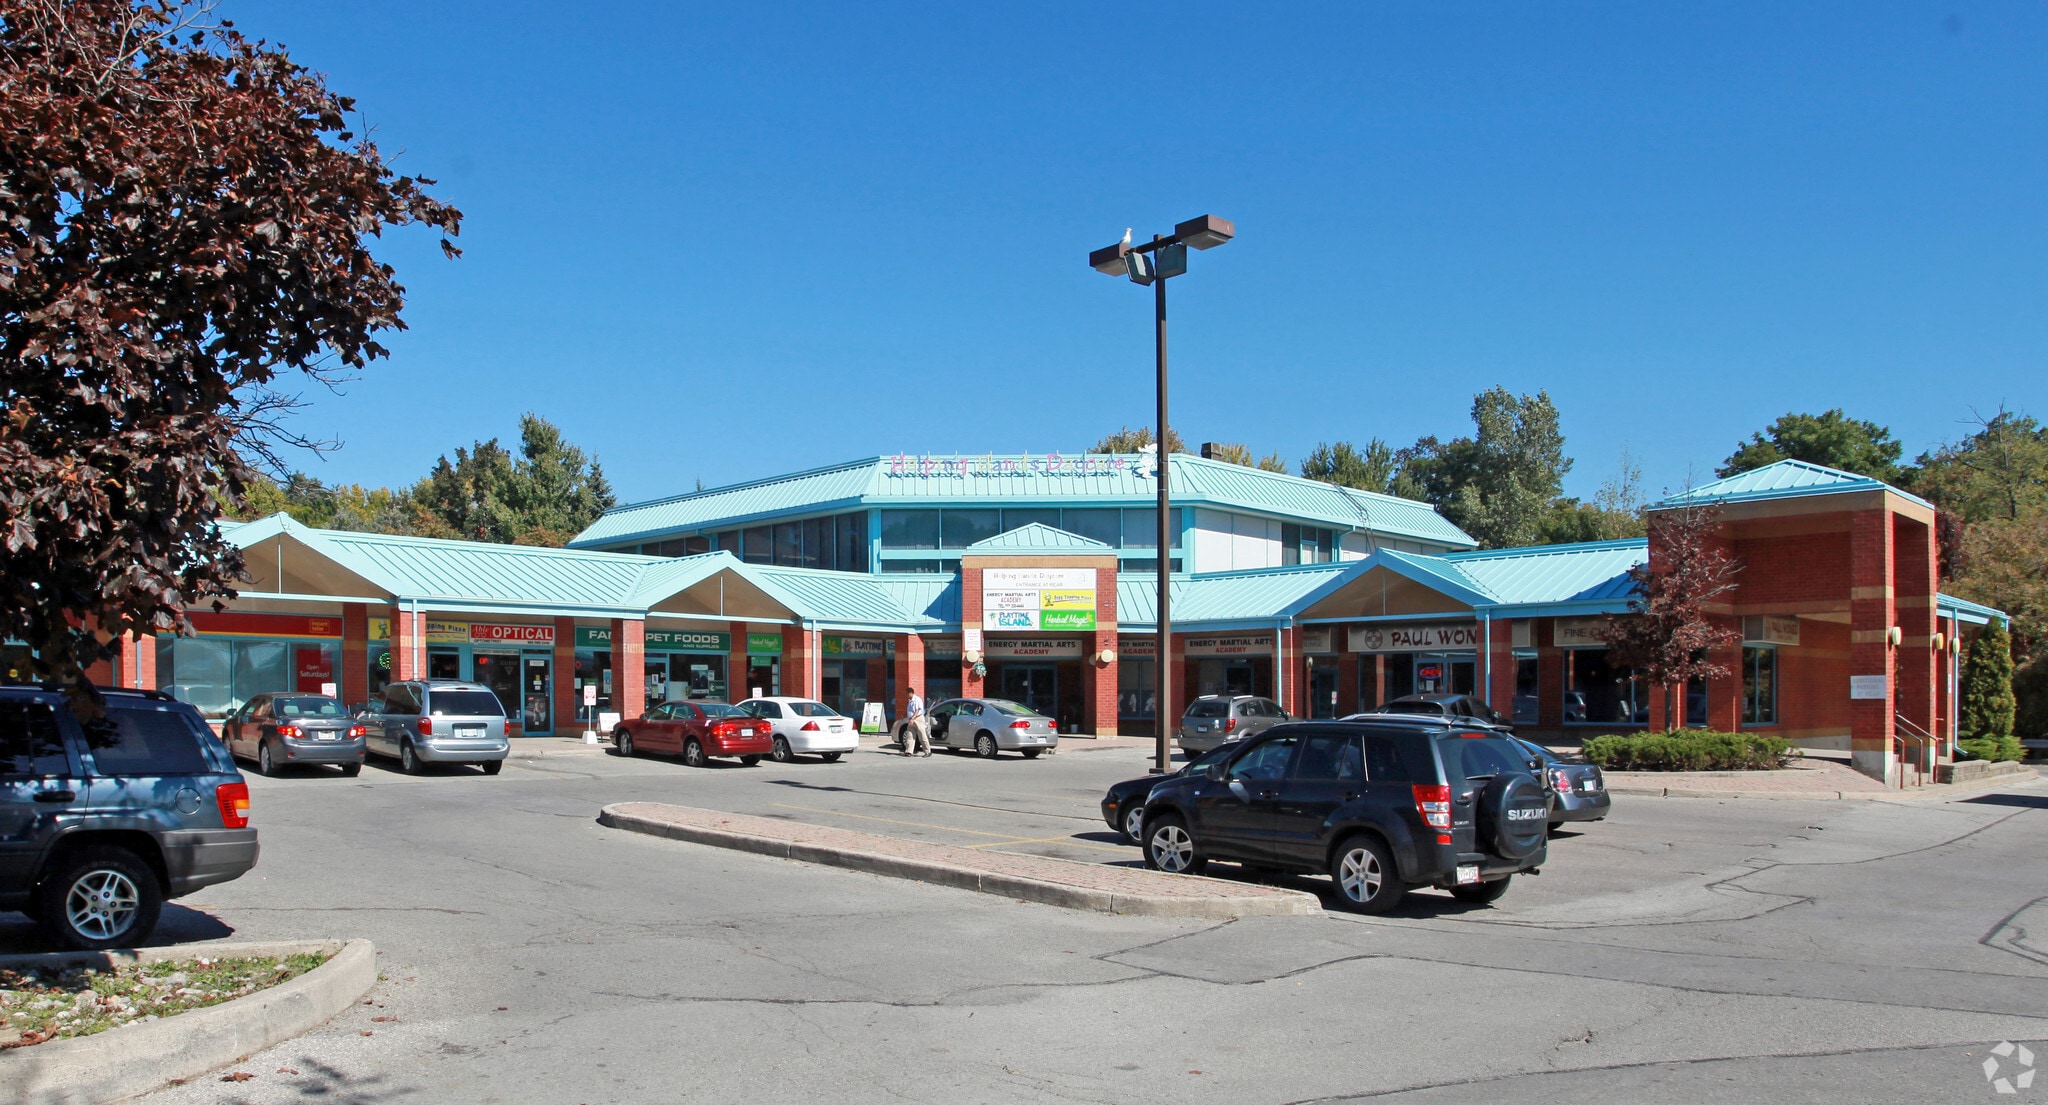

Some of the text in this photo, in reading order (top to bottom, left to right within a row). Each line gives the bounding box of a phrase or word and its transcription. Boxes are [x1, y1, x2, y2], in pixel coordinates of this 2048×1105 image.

[891, 454, 1126, 476] Helping Hands Daycare
[998, 618, 1031, 627] ISLAND
[1045, 614, 1088, 627] Herbal Magic
[492, 627, 553, 640] OPTICAL
[645, 633, 671, 642] PET
[674, 634, 720, 644] FOODS
[1391, 629, 1477, 646] PAUL WON
[1564, 627, 1586, 638] FINE
[854, 641, 882, 650] PLAYTIME
[1220, 638, 1252, 646] MARTIAL
[1507, 808, 1547, 821] SUZUKI
